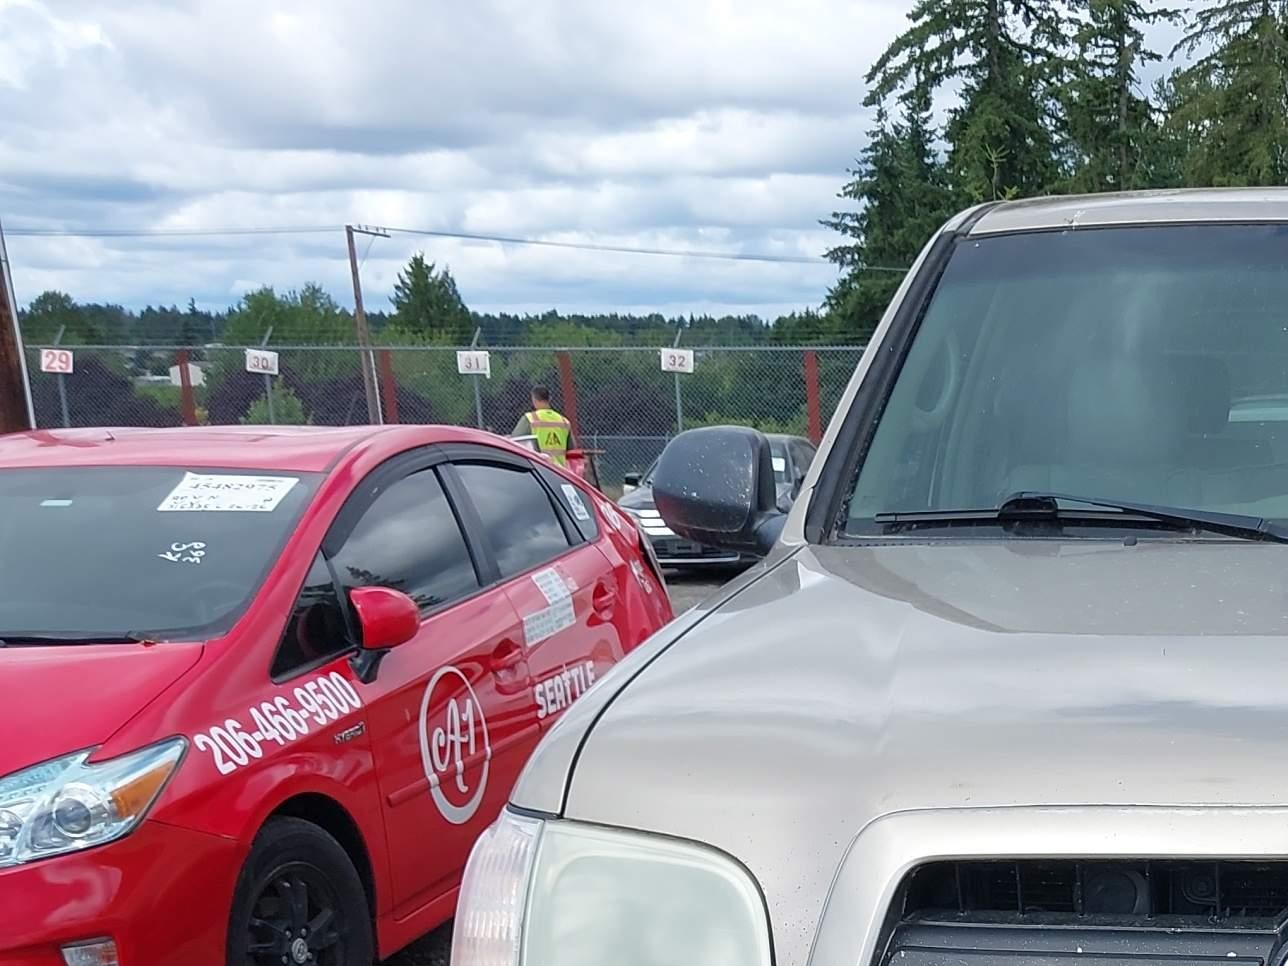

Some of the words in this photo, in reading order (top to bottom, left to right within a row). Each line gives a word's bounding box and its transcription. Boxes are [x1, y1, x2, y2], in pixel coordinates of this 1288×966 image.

[44, 351, 71, 372] 29
[251, 355, 270, 370] 30
[464, 356, 480, 370] 31
[668, 355, 686, 368] 32
[193, 670, 362, 775] 206-466-9500
